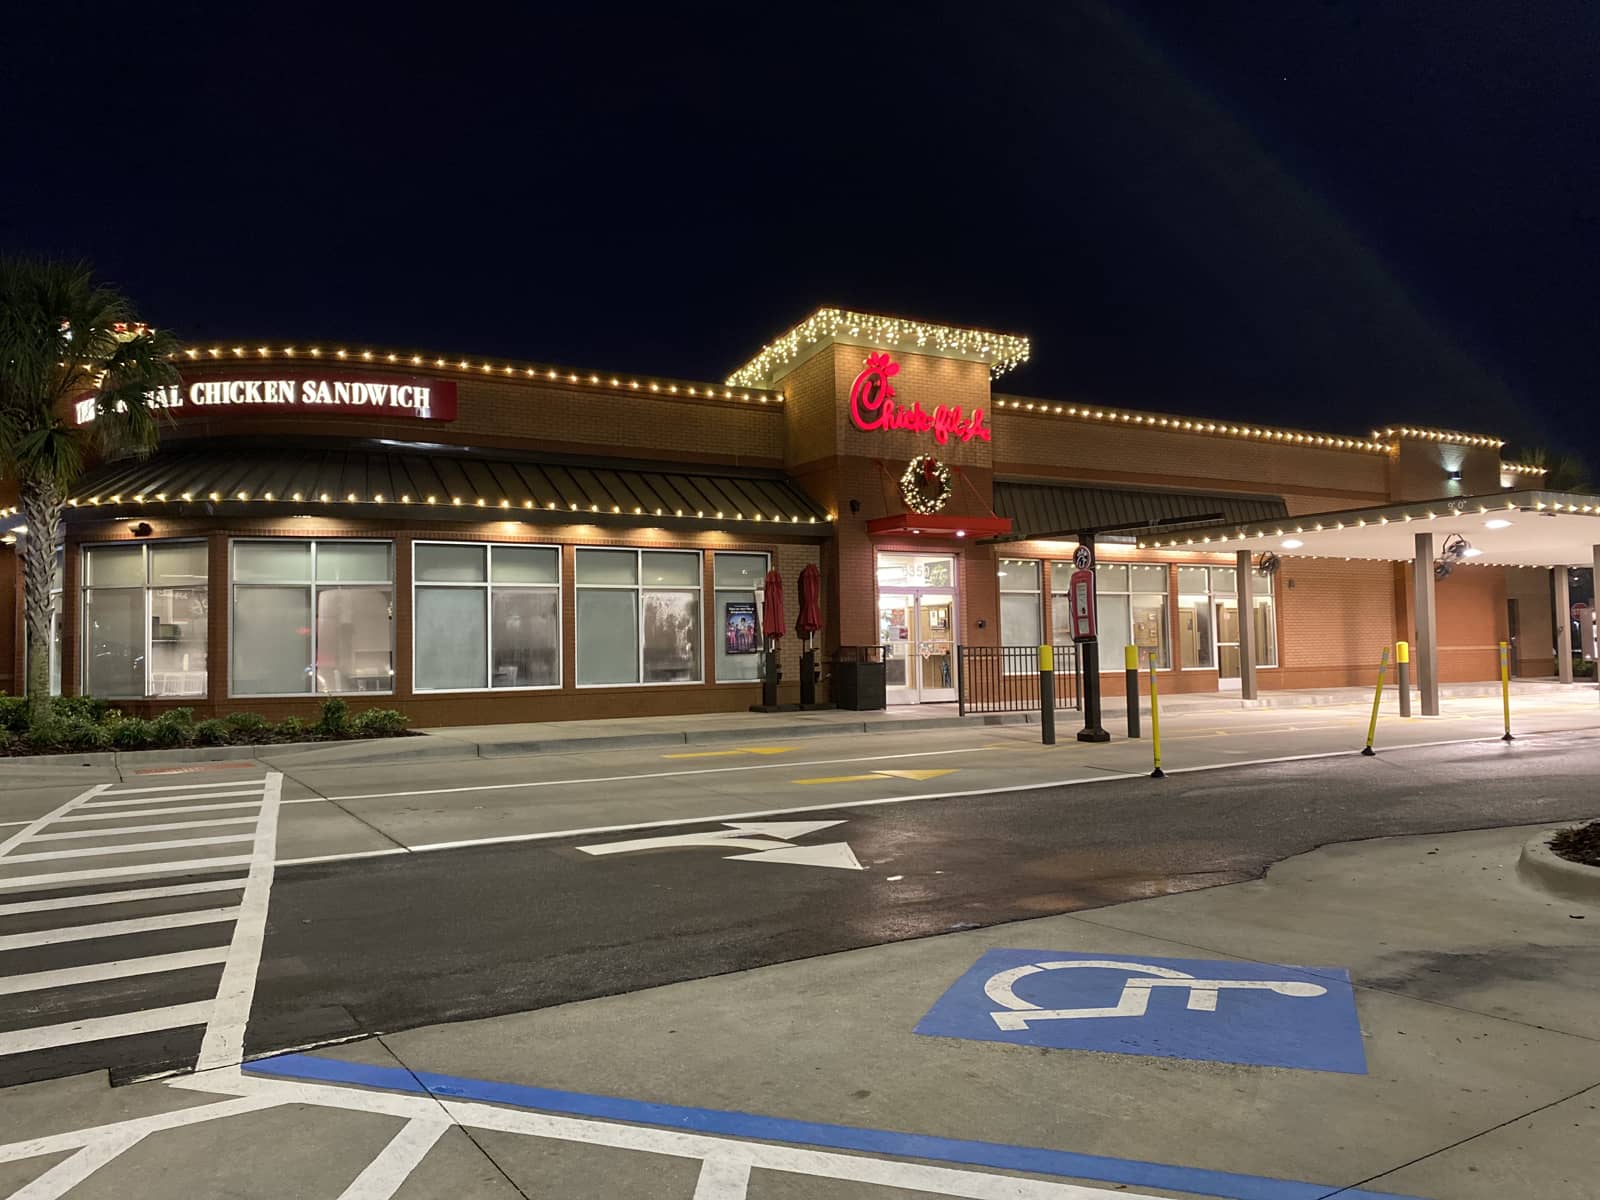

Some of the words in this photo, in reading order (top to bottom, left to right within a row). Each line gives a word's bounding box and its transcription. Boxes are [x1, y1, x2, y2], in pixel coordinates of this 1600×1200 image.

[189, 380, 295, 405] CHICKEN
[302, 380, 430, 408] SANDWICH
[849, 352, 991, 444] Chick-fil-A
